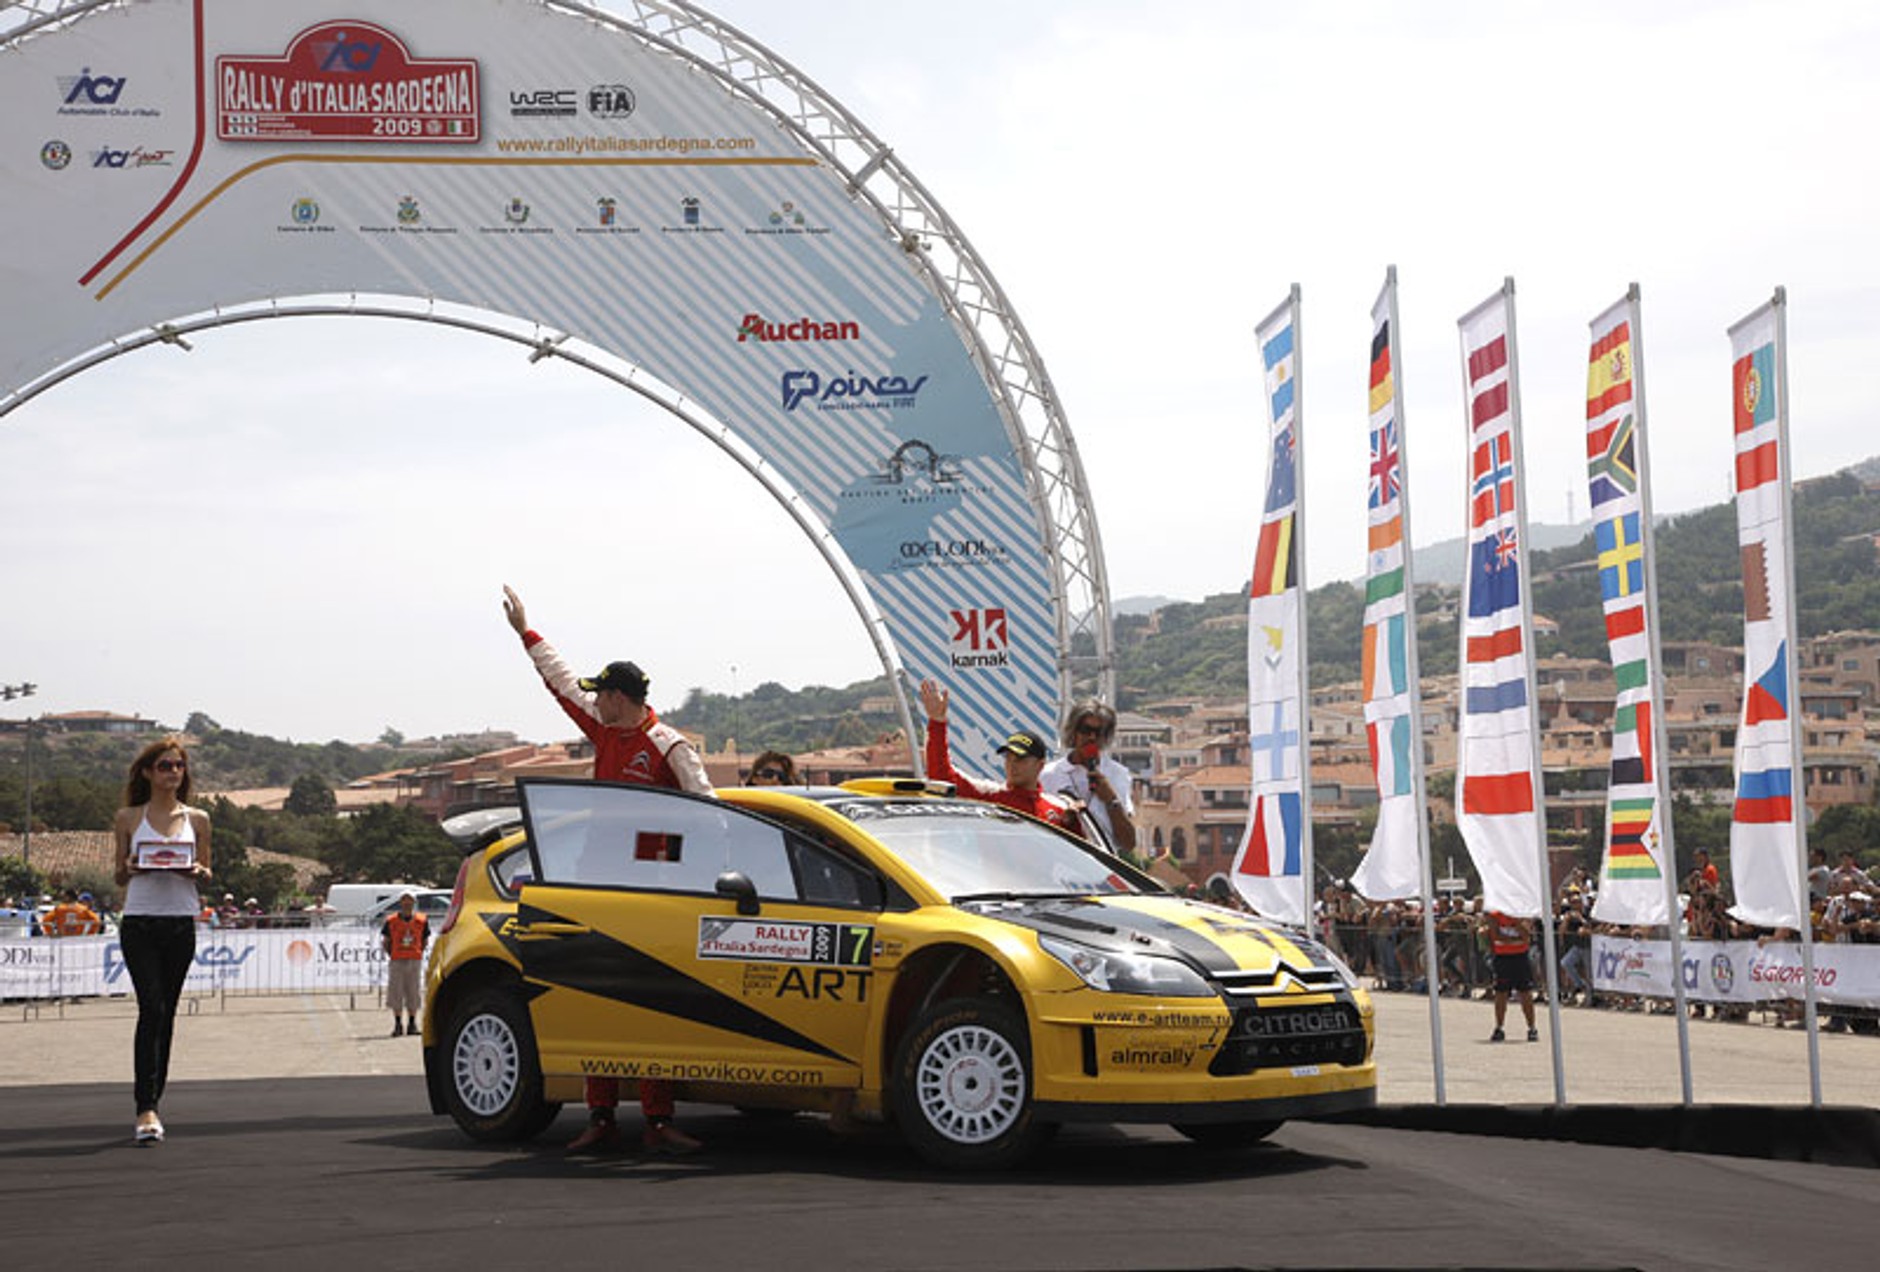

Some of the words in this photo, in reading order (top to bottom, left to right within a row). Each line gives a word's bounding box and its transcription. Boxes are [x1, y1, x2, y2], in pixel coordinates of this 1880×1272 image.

[225, 65, 284, 110] RALLY
[510, 91, 577, 105] WRC
[590, 92, 630, 112] FIA
[373, 117, 422, 135] 2009
[497, 136, 756, 154] www.rallyitaliasardegna.com
[738, 314, 860, 342] Auchan
[952, 652, 1007, 667] karnak
[755, 926, 810, 941] RALLY
[815, 926, 831, 961] 2009
[748, 942, 808, 957] Sardegna
[850, 927, 870, 964] 7
[775, 966, 873, 1003] ART
[1112, 1048, 1195, 1066] almrally
[580, 1059, 824, 1085] www.e-novikov.com
